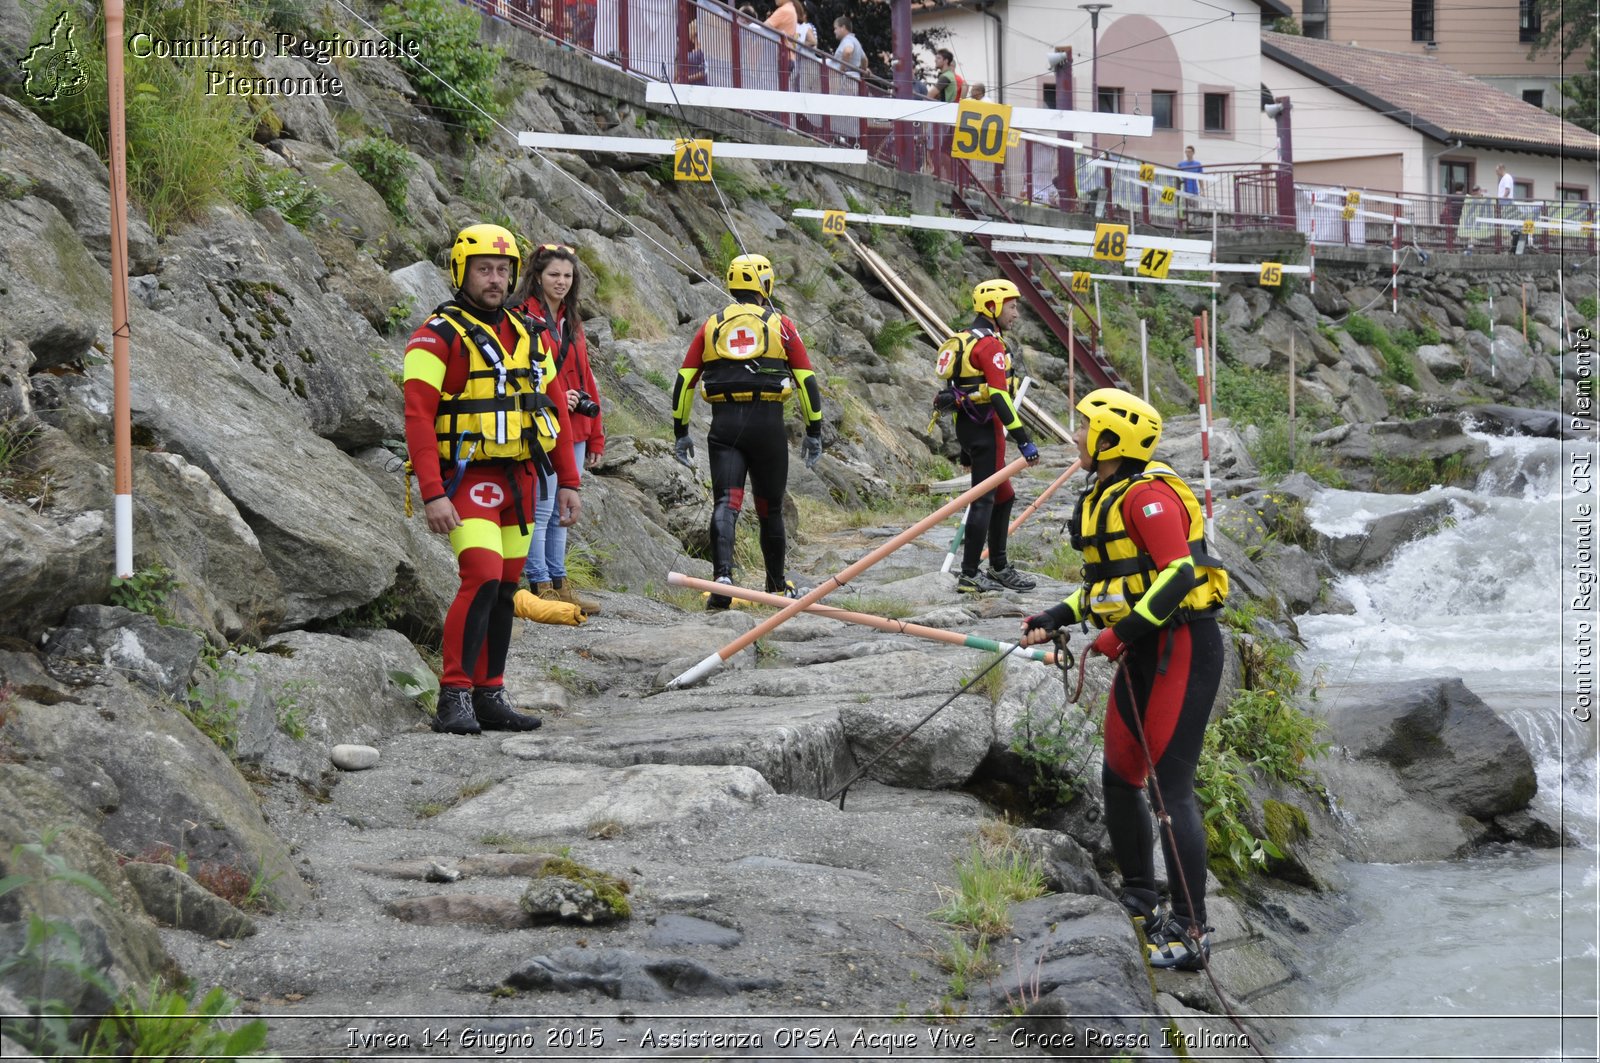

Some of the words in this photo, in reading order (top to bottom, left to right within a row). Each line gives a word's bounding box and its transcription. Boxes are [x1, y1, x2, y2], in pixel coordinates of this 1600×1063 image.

[957, 111, 1003, 156] 50
[677, 147, 709, 177] 49
[1140, 167, 1153, 181] 42
[1161, 190, 1174, 202] 40
[824, 214, 844, 232] 46
[1096, 231, 1125, 257] 48
[1141, 249, 1168, 271] 47
[1073, 276, 1089, 290] 44
[1262, 267, 1279, 283] 45
